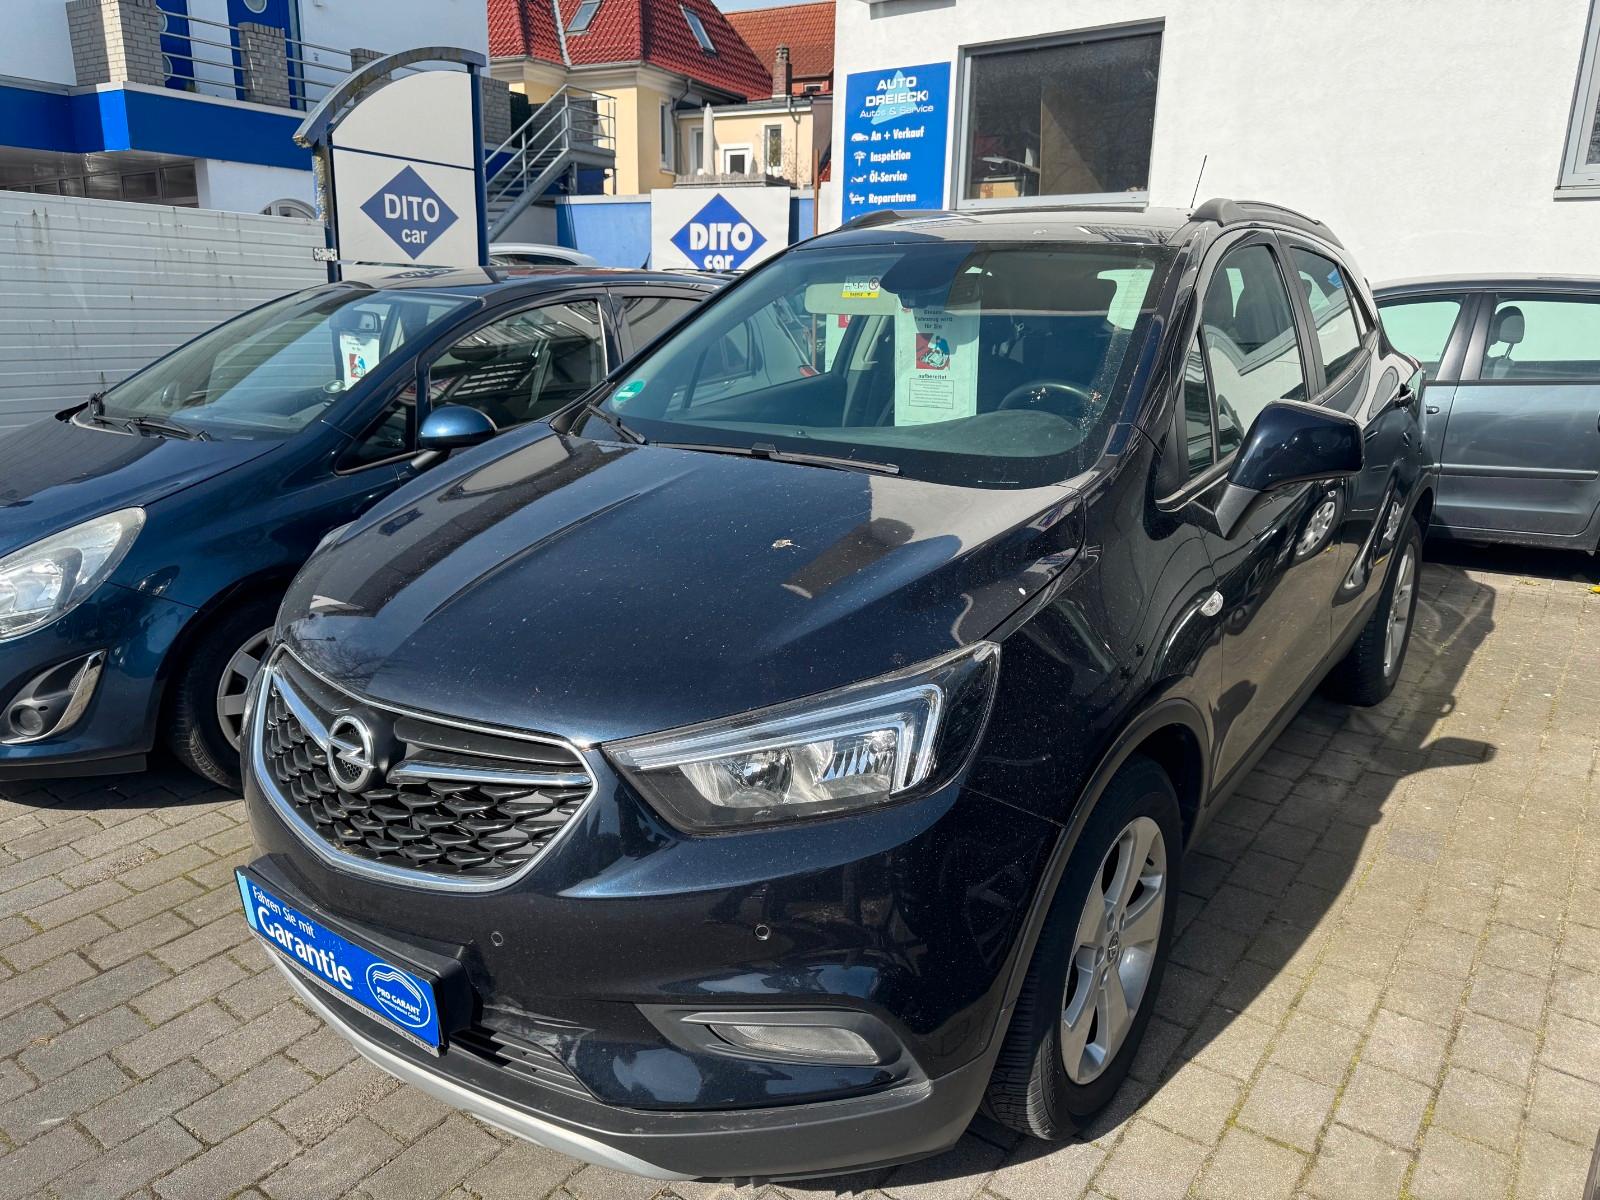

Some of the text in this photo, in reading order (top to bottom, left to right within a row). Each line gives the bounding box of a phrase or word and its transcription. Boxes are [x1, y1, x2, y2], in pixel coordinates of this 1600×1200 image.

[876, 76, 917, 91] AUTO
[889, 106, 897, 116] &
[899, 104, 934, 115] Service
[870, 130, 882, 142] An
[892, 126, 925, 140] Verkauf
[870, 149, 911, 164] Inspektion
[869, 170, 908, 184] Öl-Service
[868, 192, 917, 206] Reparaturen
[383, 193, 440, 223] DITO
[401, 228, 428, 244] car
[689, 222, 754, 251] DITO
[703, 254, 734, 270] car
[252, 886, 316, 939] Fahren Sie mit
[258, 906, 353, 991] Garantie
[376, 986, 391, 1000] PRO
[391, 995, 420, 1016] GARANT
